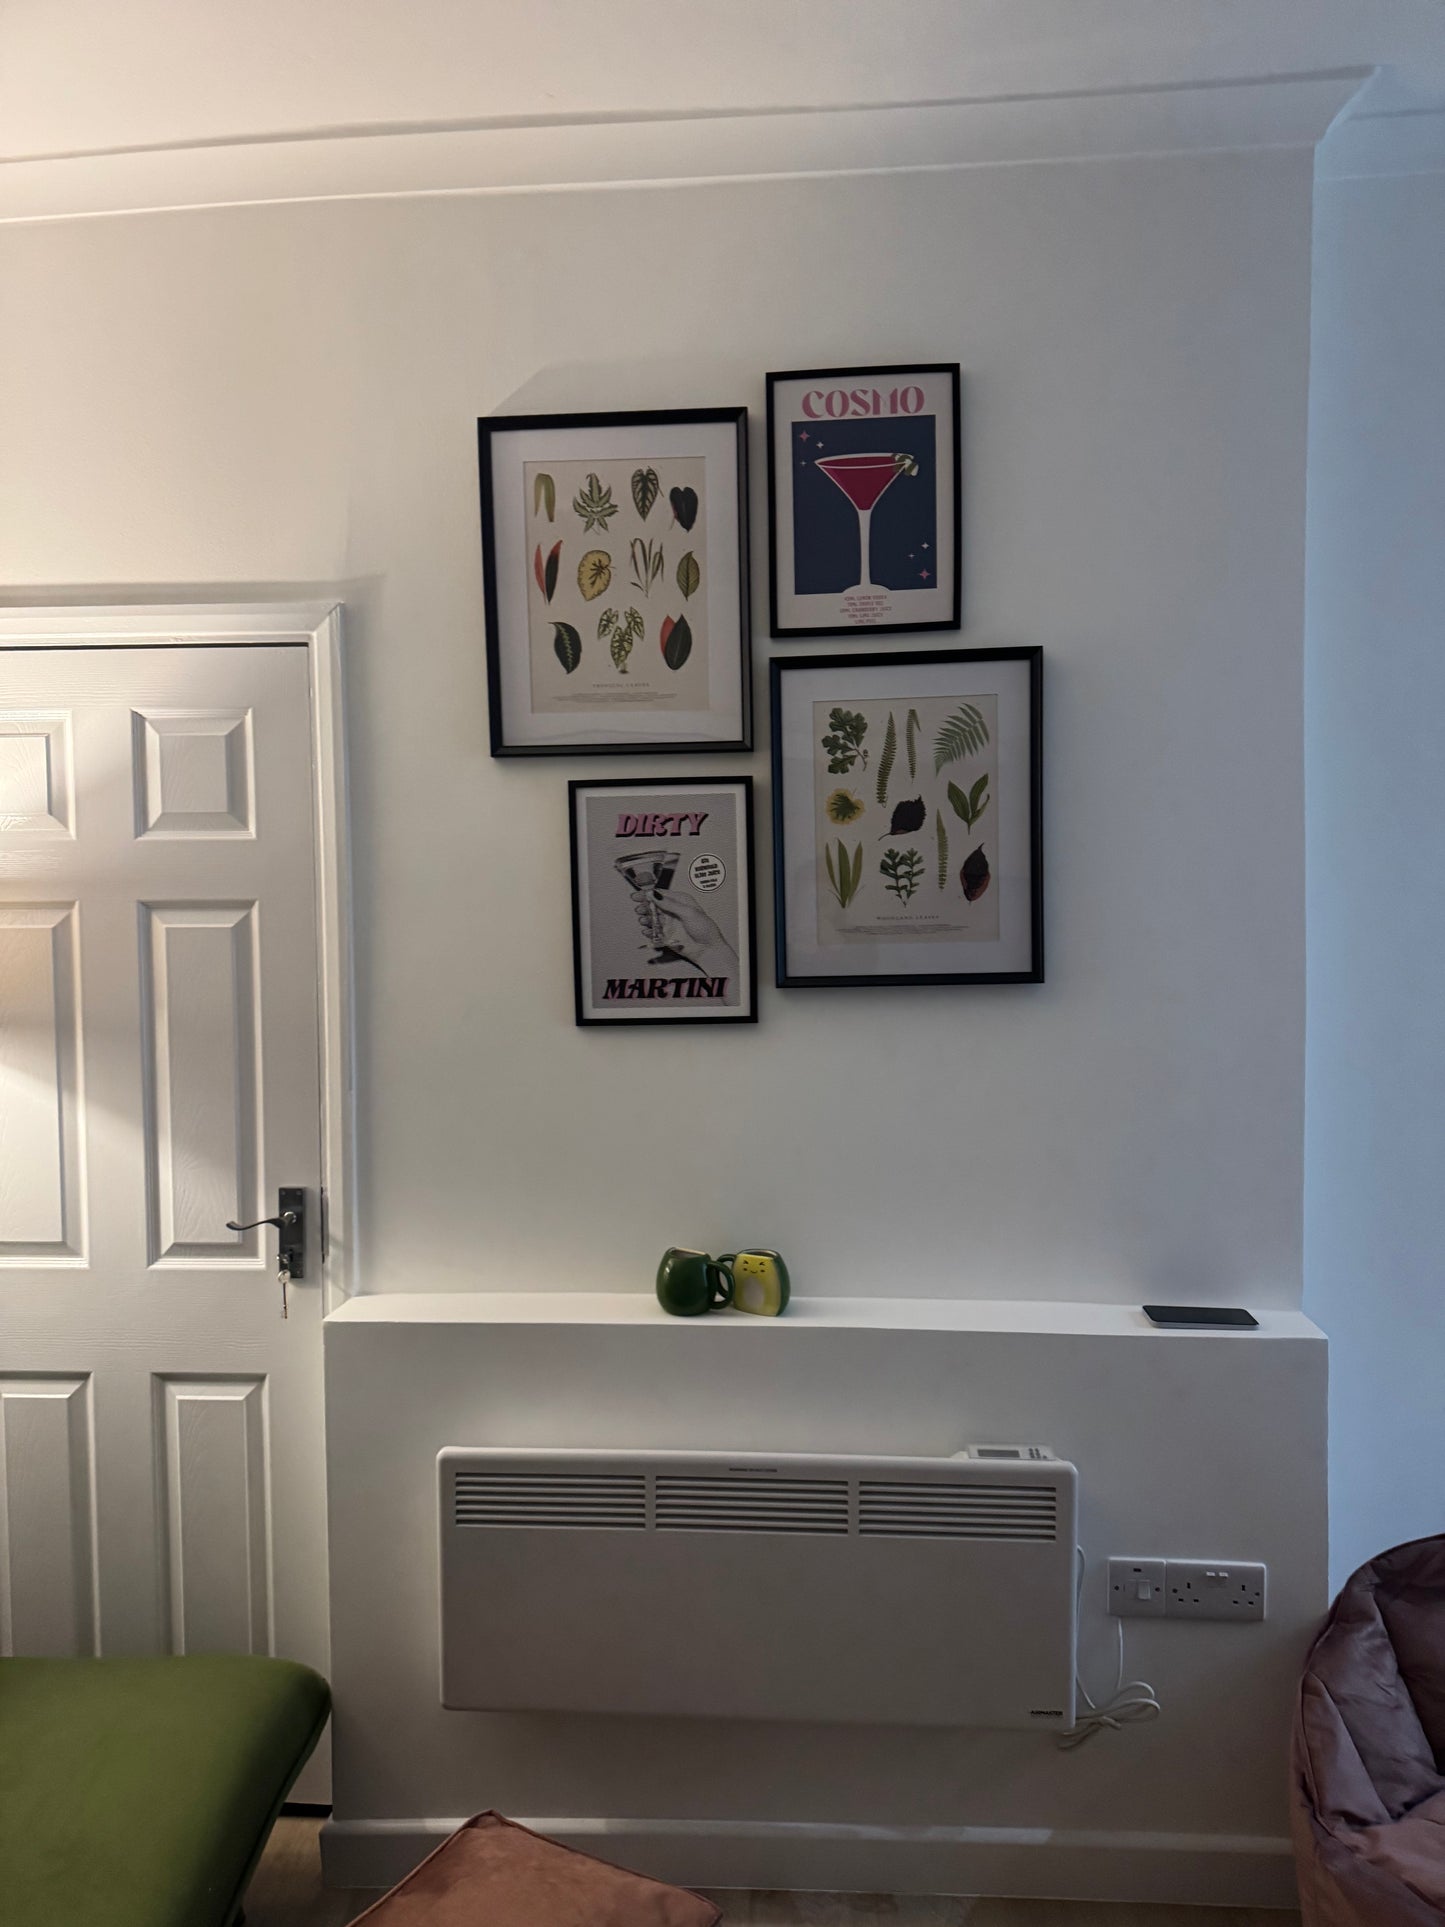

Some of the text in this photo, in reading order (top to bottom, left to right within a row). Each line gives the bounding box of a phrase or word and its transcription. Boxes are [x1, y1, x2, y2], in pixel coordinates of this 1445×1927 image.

[802, 386, 924, 418] COSMO
[615, 812, 709, 838] DIRTY
[602, 977, 729, 1000] MARTINI
